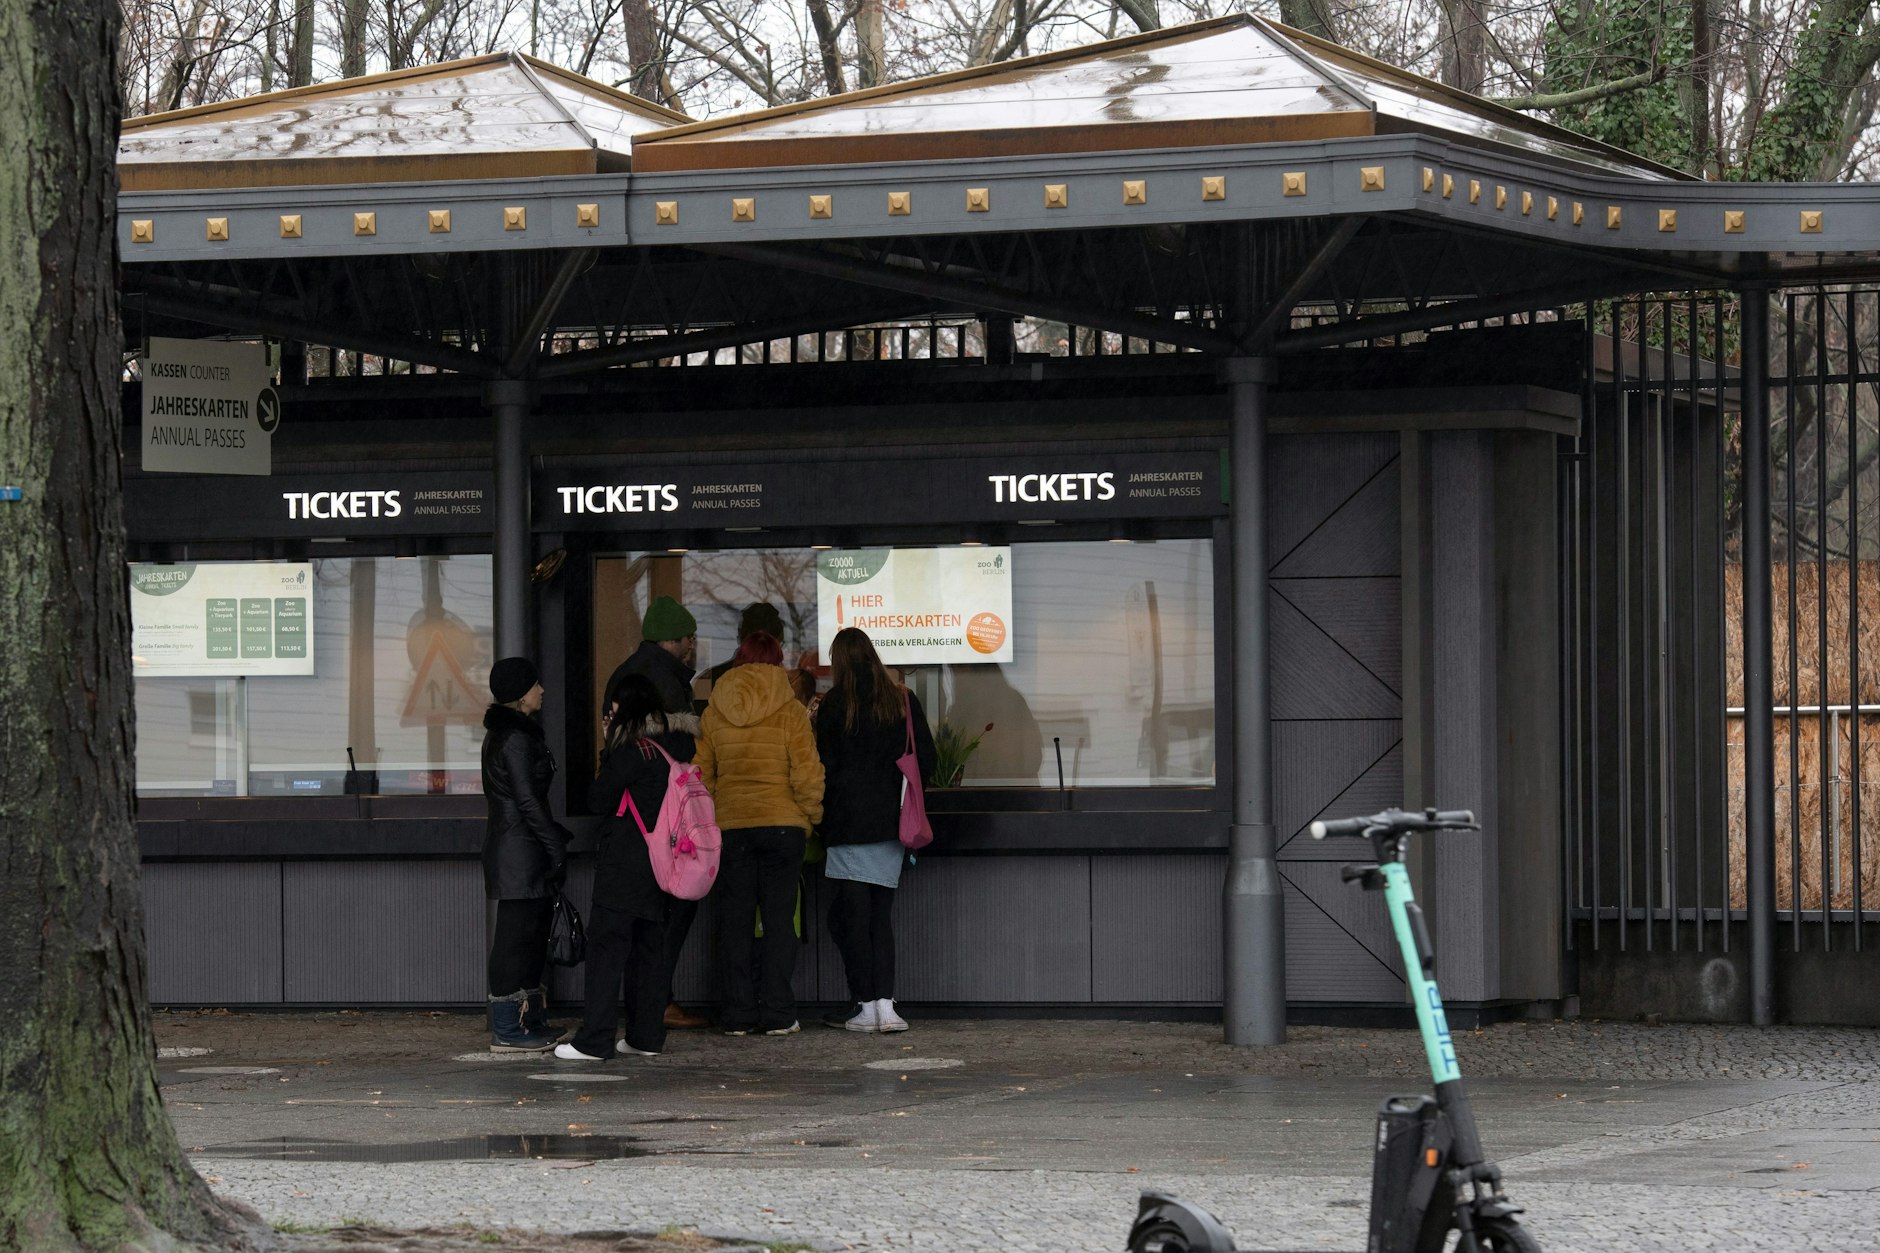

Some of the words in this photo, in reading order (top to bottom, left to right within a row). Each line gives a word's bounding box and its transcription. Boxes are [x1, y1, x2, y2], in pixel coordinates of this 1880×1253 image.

[150, 363, 187, 379] KASSEN
[190, 365, 230, 381] COUNTER
[150, 396, 249, 419] JAHRESKARTEN
[151, 426, 201, 447] ANNUAL
[205, 428, 246, 449] PASSES
[1128, 472, 1203, 483] JAHRESKARTEN
[691, 484, 762, 494] JAHRESKARTEN
[988, 472, 1116, 503] TICKETS
[1129, 488, 1167, 498] ANNUAL
[1169, 487, 1201, 496] PASSES
[413, 490, 483, 500] JAHRESKARTEN
[557, 484, 679, 514] TICKETS
[283, 490, 402, 519] TICKETS
[414, 505, 449, 515] ANNUAL
[451, 505, 482, 514] PASSES
[692, 500, 728, 509] ANNUAL
[730, 499, 761, 508] PASSES
[136, 571, 188, 585] JAHRESKARTEN
[837, 568, 869, 580] AKTUELL
[851, 594, 883, 608] HIER
[853, 614, 961, 629] JAHRESKARTEN
[898, 639, 905, 647] &
[905, 637, 962, 647] VERLÄNGERN
